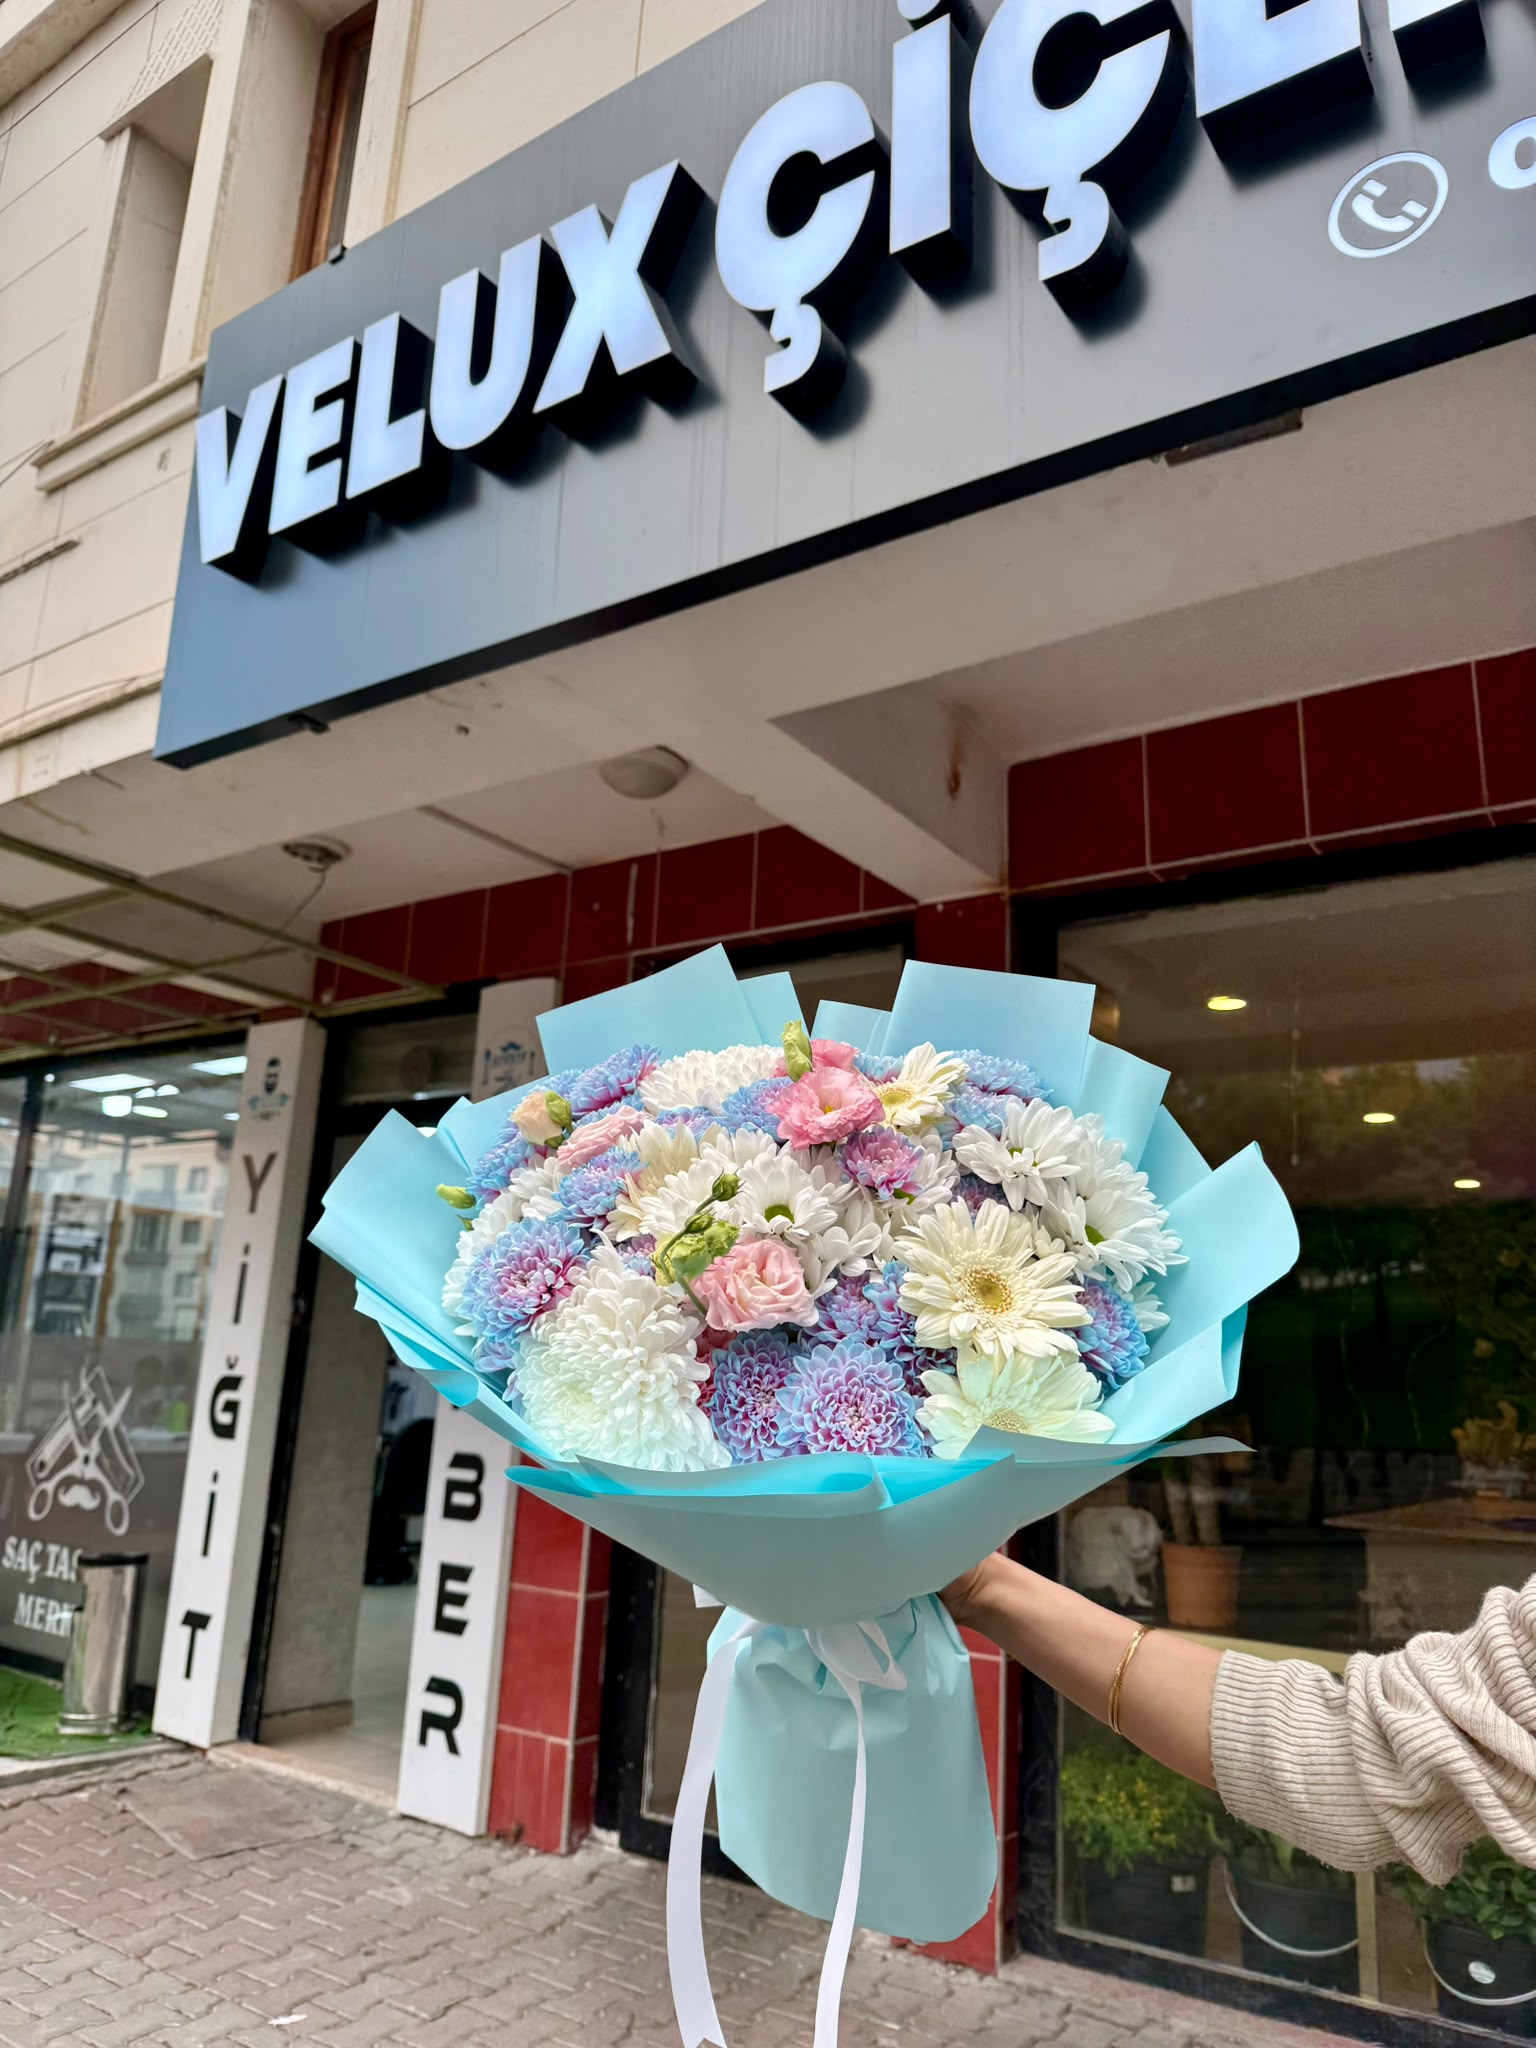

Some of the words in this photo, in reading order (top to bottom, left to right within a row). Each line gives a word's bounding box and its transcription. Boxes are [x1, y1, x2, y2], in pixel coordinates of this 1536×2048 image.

[196, 160, 673, 564] VELUX
[715, 0, 1466, 393] ÇİÇ
[1, 1535, 43, 1584] SAÇ
[180, 1151, 277, 1680] YİĞİT
[418, 1403, 486, 1757] BER
